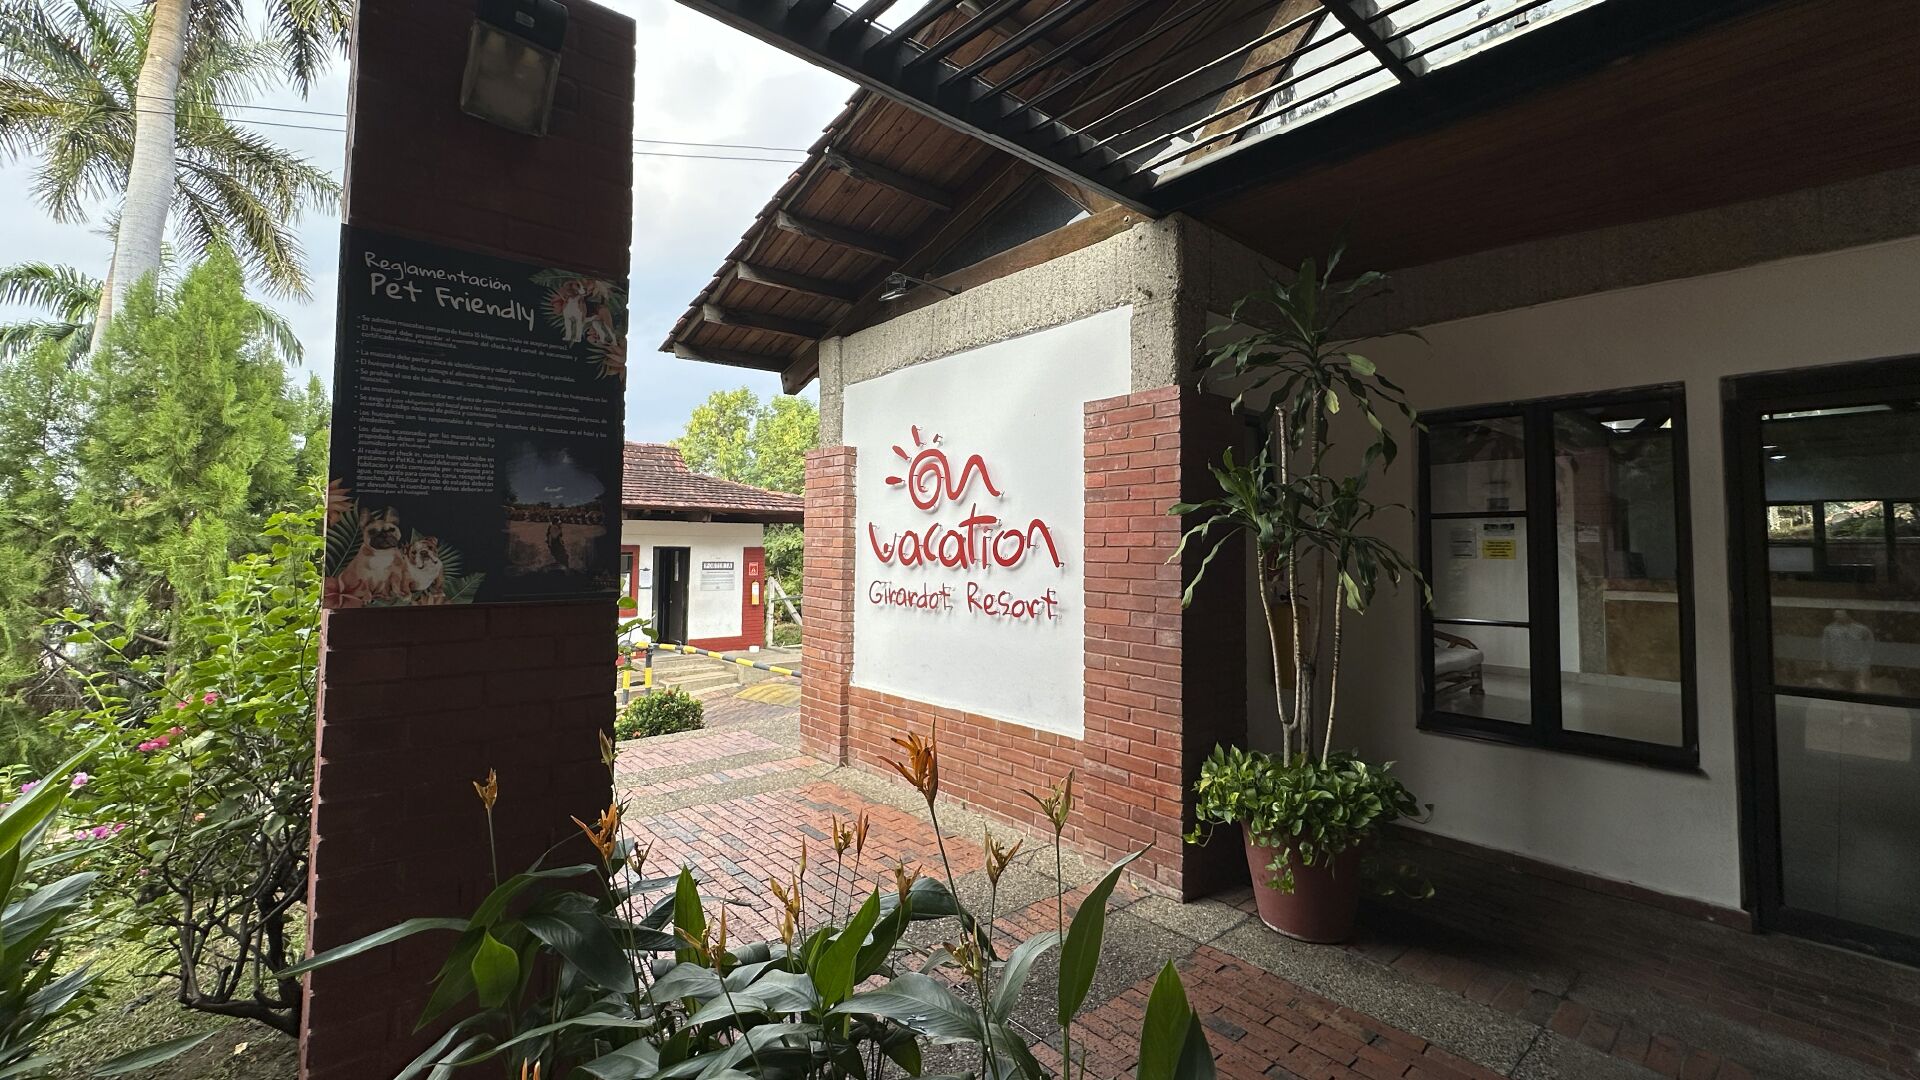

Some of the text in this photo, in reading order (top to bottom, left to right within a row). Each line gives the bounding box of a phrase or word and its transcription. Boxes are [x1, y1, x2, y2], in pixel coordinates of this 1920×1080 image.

[365, 252, 512, 293] Reglamentación
[371, 272, 535, 331] Pet Friendly
[869, 581, 1058, 619] Girardot Resort
